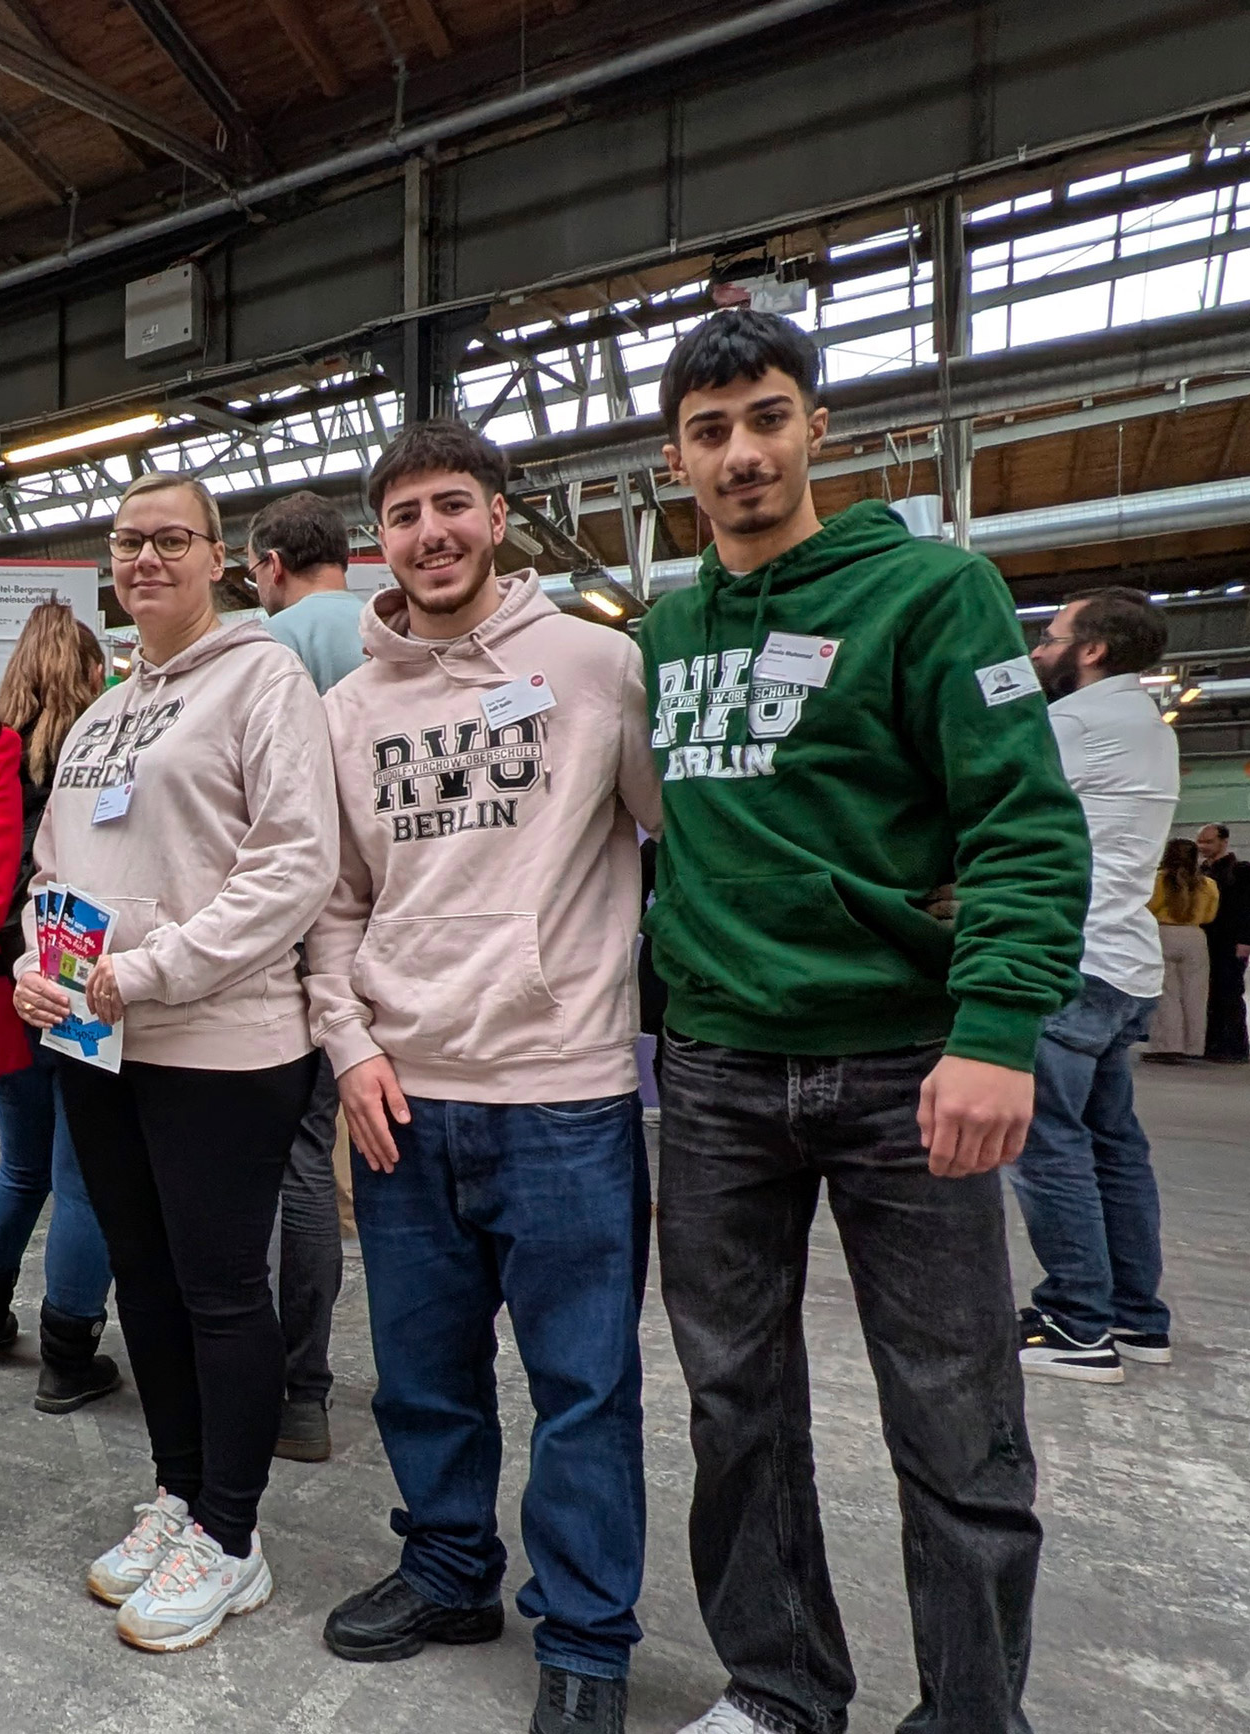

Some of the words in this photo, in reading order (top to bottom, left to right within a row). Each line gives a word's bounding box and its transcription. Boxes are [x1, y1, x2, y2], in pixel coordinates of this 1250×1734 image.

[372, 717, 543, 815] RVO
[376, 745, 539, 784] RUDOLF-VIRCHOW-OBERSCHULE
[663, 742, 778, 782] BRLIN
[392, 797, 519, 844] BERLIN
